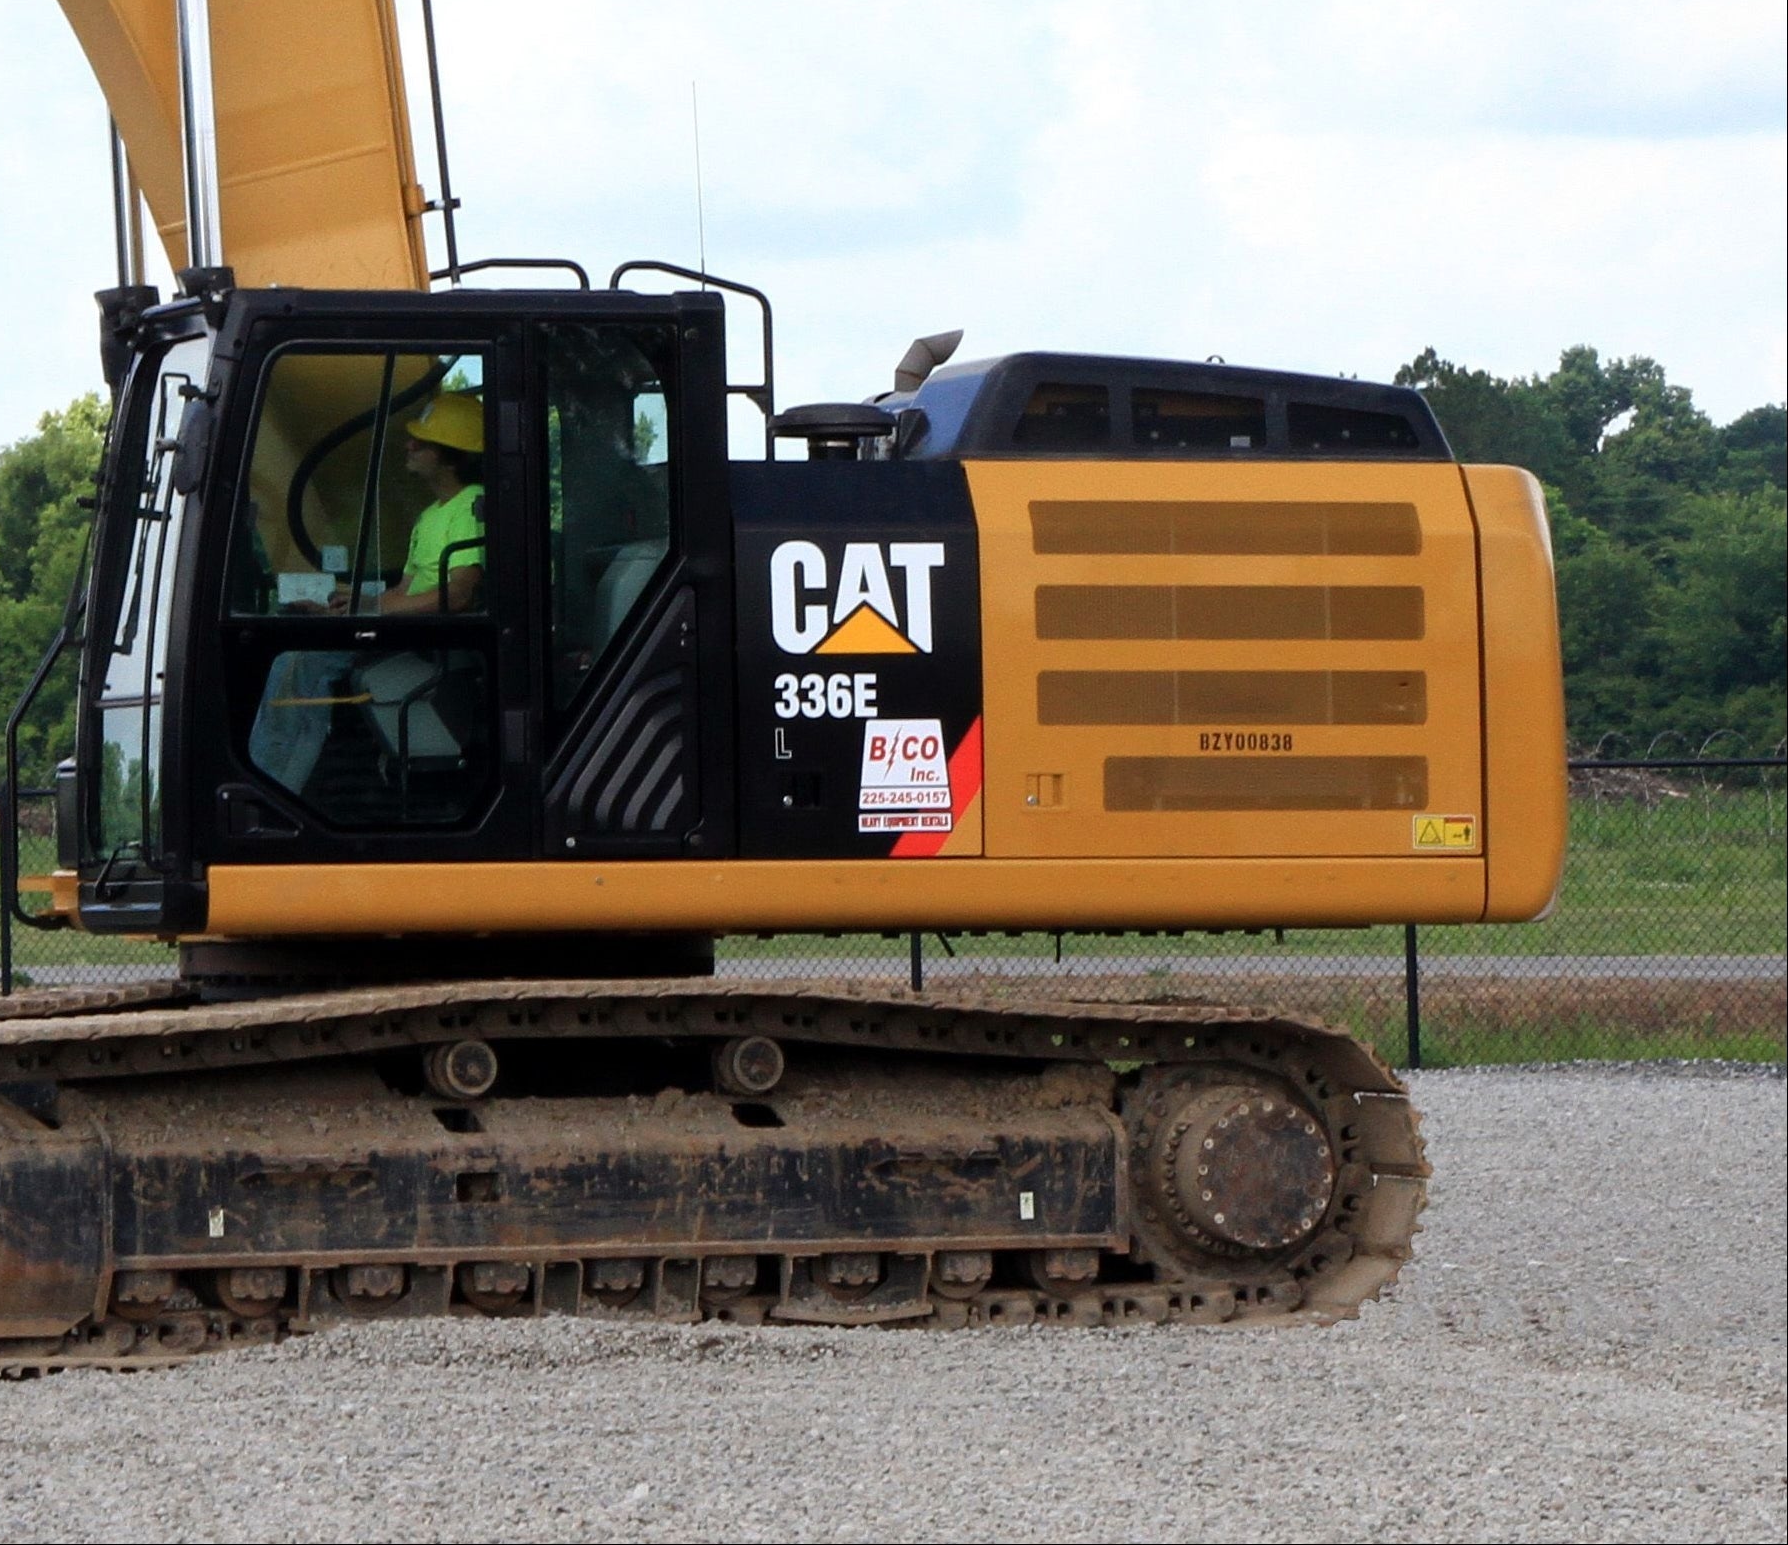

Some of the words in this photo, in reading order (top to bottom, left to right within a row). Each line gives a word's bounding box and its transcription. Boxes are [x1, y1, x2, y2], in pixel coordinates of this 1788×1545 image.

[770, 539, 946, 655] CAT
[774, 672, 878, 719] 336E
[774, 727, 793, 760] L
[1199, 733, 1293, 751] BZY00838
[910, 767, 941, 782] Inc.
[862, 791, 948, 805] 225-245-0157
